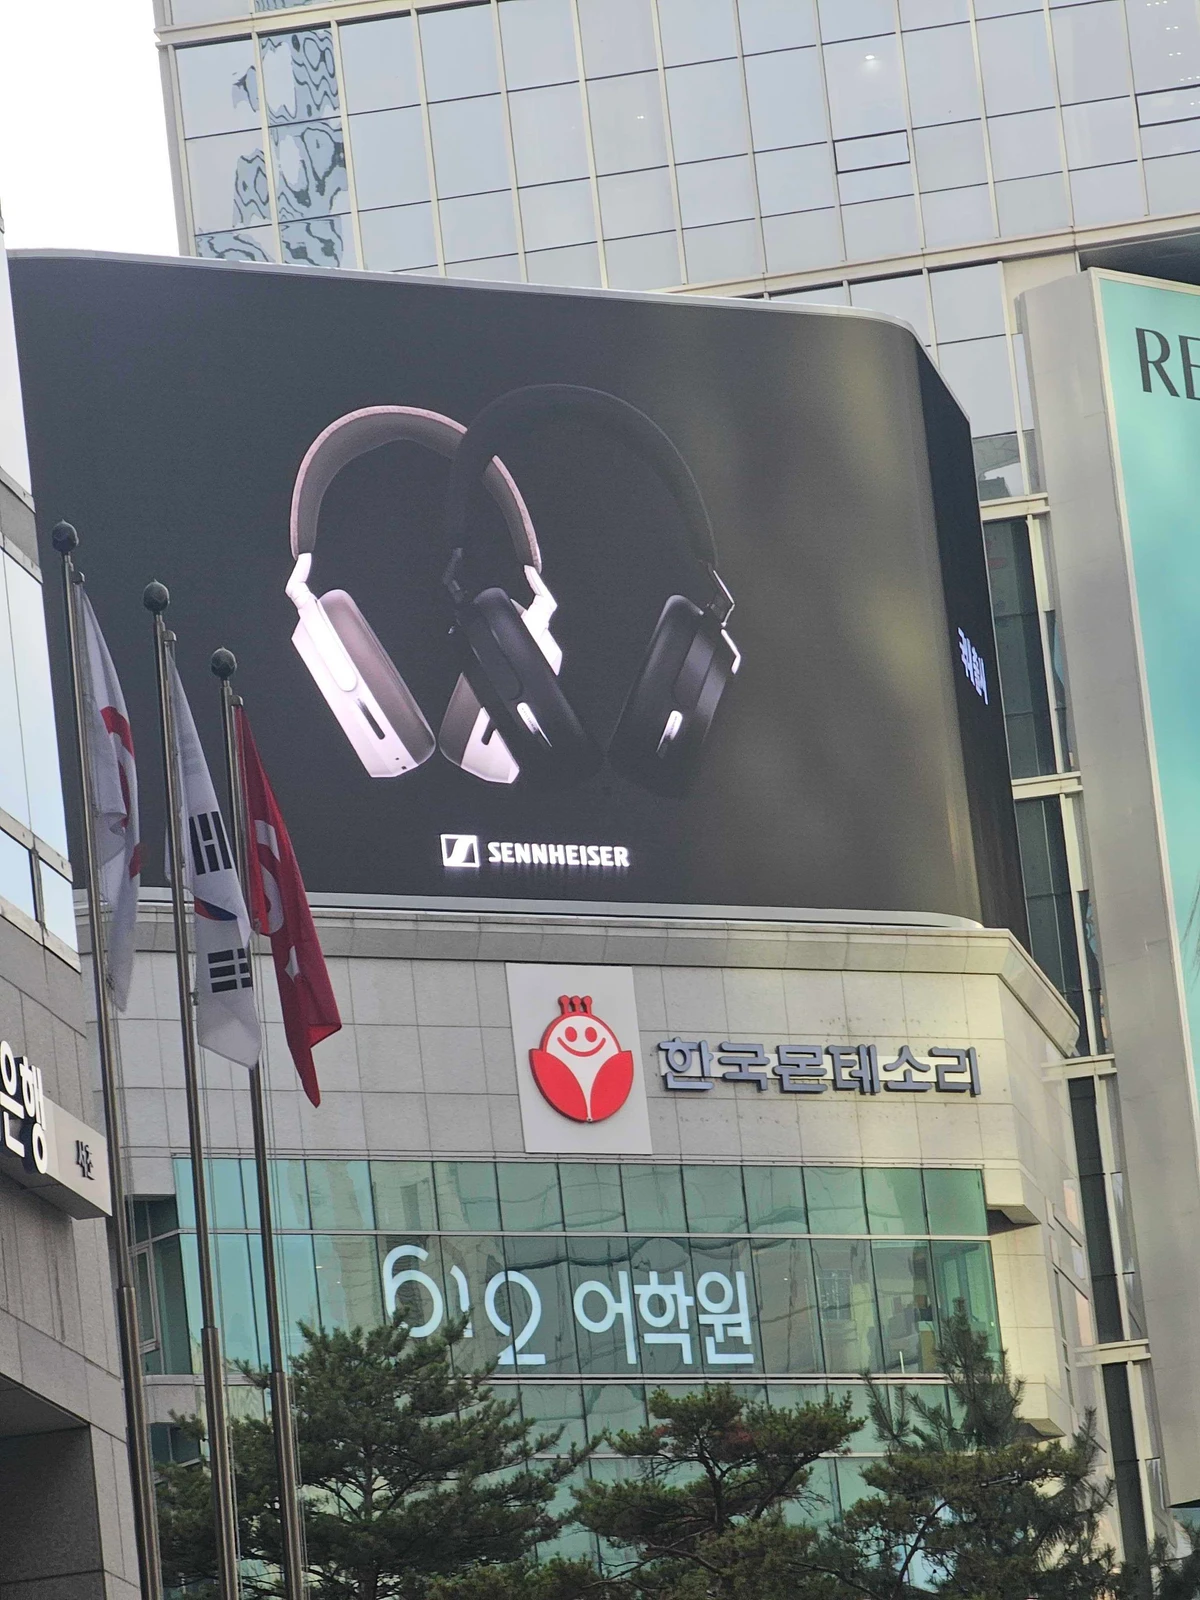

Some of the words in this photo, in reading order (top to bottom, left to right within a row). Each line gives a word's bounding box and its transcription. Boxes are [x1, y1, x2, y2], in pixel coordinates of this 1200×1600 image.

[487, 841, 630, 867] SENNHEISER
[658, 1037, 981, 1095] 한국몬테소리
[0, 1040, 47, 1174] 은행
[573, 1270, 754, 1365] 어학원
